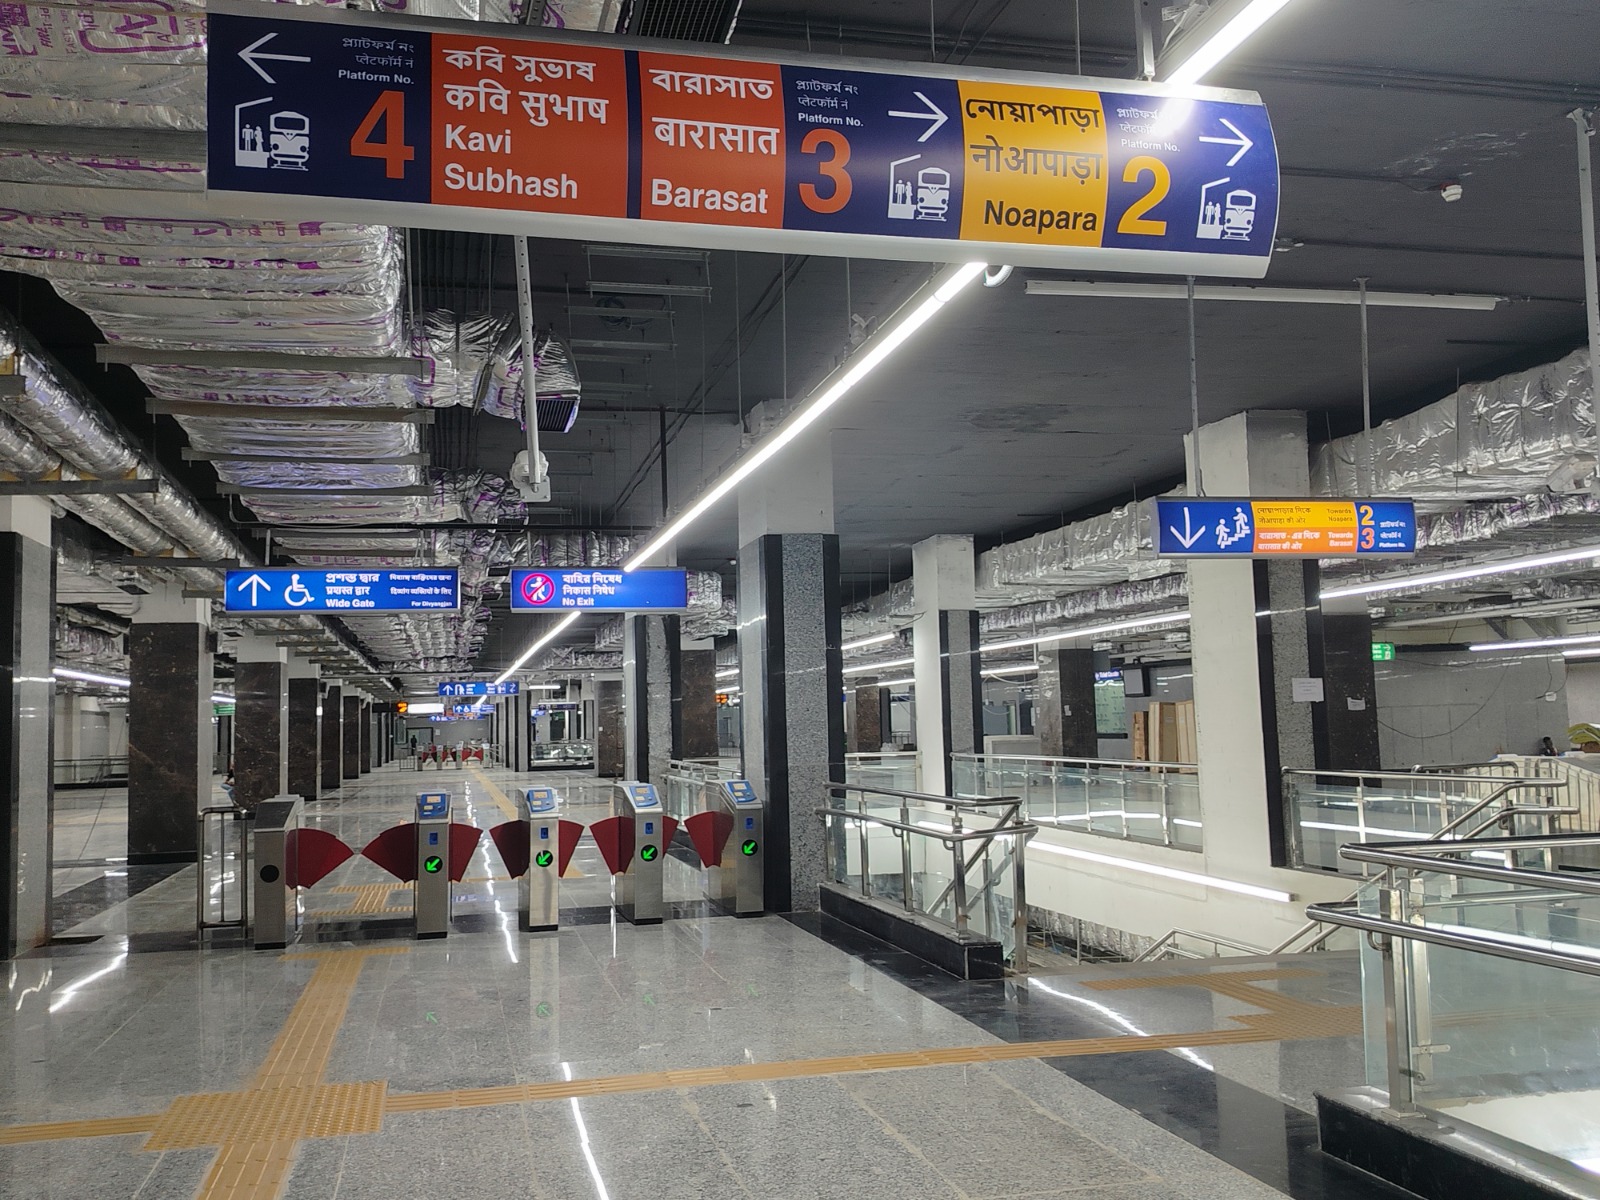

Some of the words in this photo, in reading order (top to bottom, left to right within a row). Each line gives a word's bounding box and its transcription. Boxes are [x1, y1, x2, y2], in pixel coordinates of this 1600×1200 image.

[342, 37, 396, 50] প্ল্যাটফর্ম
[397, 42, 414, 53] নং
[355, 53, 402, 67] प्लेटफॉर्म
[338, 69, 390, 82] Platform
[394, 74, 414, 84] No.
[442, 46, 506, 73] কবি
[511, 54, 597, 83] সুভাষ
[649, 68, 774, 100] বারাসাত
[795, 79, 842, 93] প্ল্যাটফর্ম
[843, 84, 859, 95] নং
[443, 78, 511, 115] कवि
[518, 91, 609, 127] सुभाष
[797, 94, 838, 109] प्लेटफॉर्म
[965, 98, 1100, 133] নোয়াপাড়া
[350, 90, 415, 179] 4
[798, 112, 843, 125] Platform
[845, 116, 864, 127] No.
[445, 123, 511, 154] Kavi
[651, 117, 780, 155] बारासात
[1121, 138, 1161, 150] Platform
[1164, 142, 1180, 152] No.
[798, 128, 853, 214] 3
[969, 135, 1104, 185] नोआपाड़ा
[444, 163, 577, 199] Subhash
[651, 178, 768, 214] Barasat
[1117, 155, 1171, 236] 2
[983, 200, 1097, 235] Noapara
[1360, 505, 1375, 526] 2
[1328, 531, 1353, 539] Towards
[1360, 527, 1375, 549] 3
[325, 599, 350, 608] Wide
[352, 599, 375, 608] Gate
[562, 598, 575, 606] No
[577, 597, 594, 606] Exit
